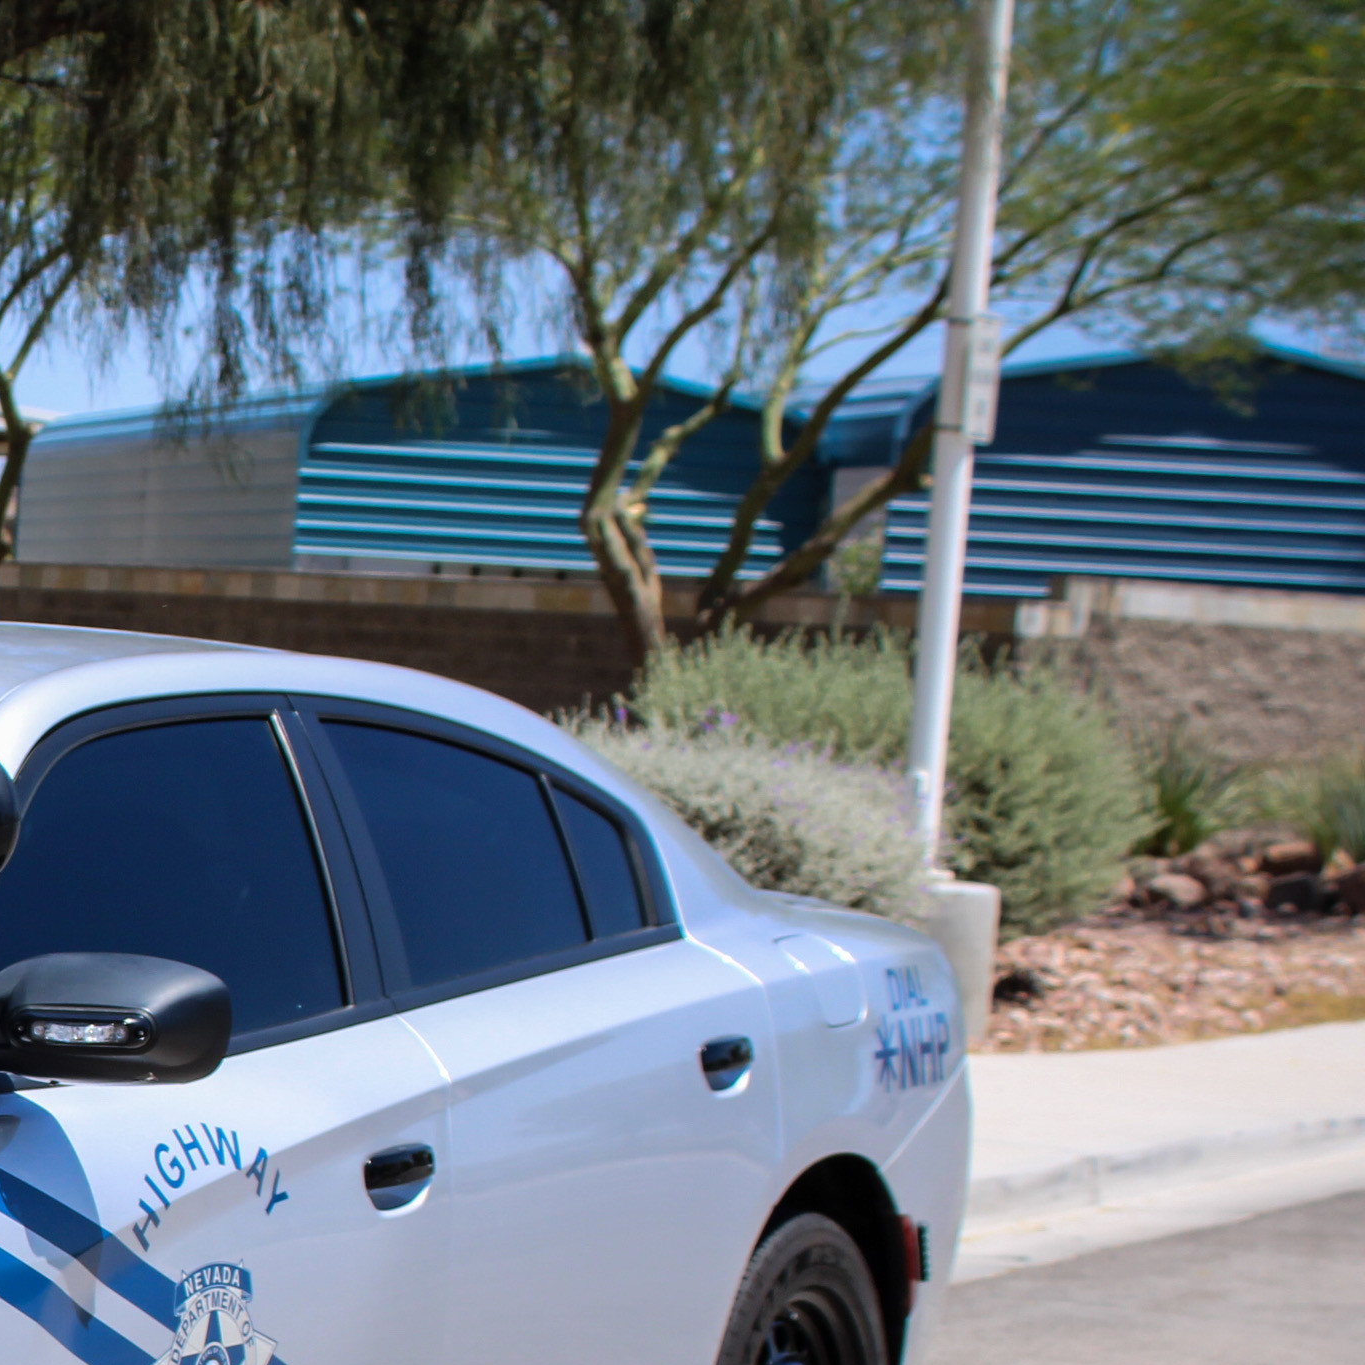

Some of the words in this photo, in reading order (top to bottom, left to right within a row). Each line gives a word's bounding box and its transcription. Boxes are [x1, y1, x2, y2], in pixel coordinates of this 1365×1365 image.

[885, 965, 929, 1011] DIAL
[132, 1122, 289, 1252] HIGHWAY
[184, 1266, 241, 1296] NEVADA
[171, 1292, 245, 1364] DEPARTMENT
[242, 1320, 255, 1348] OF
